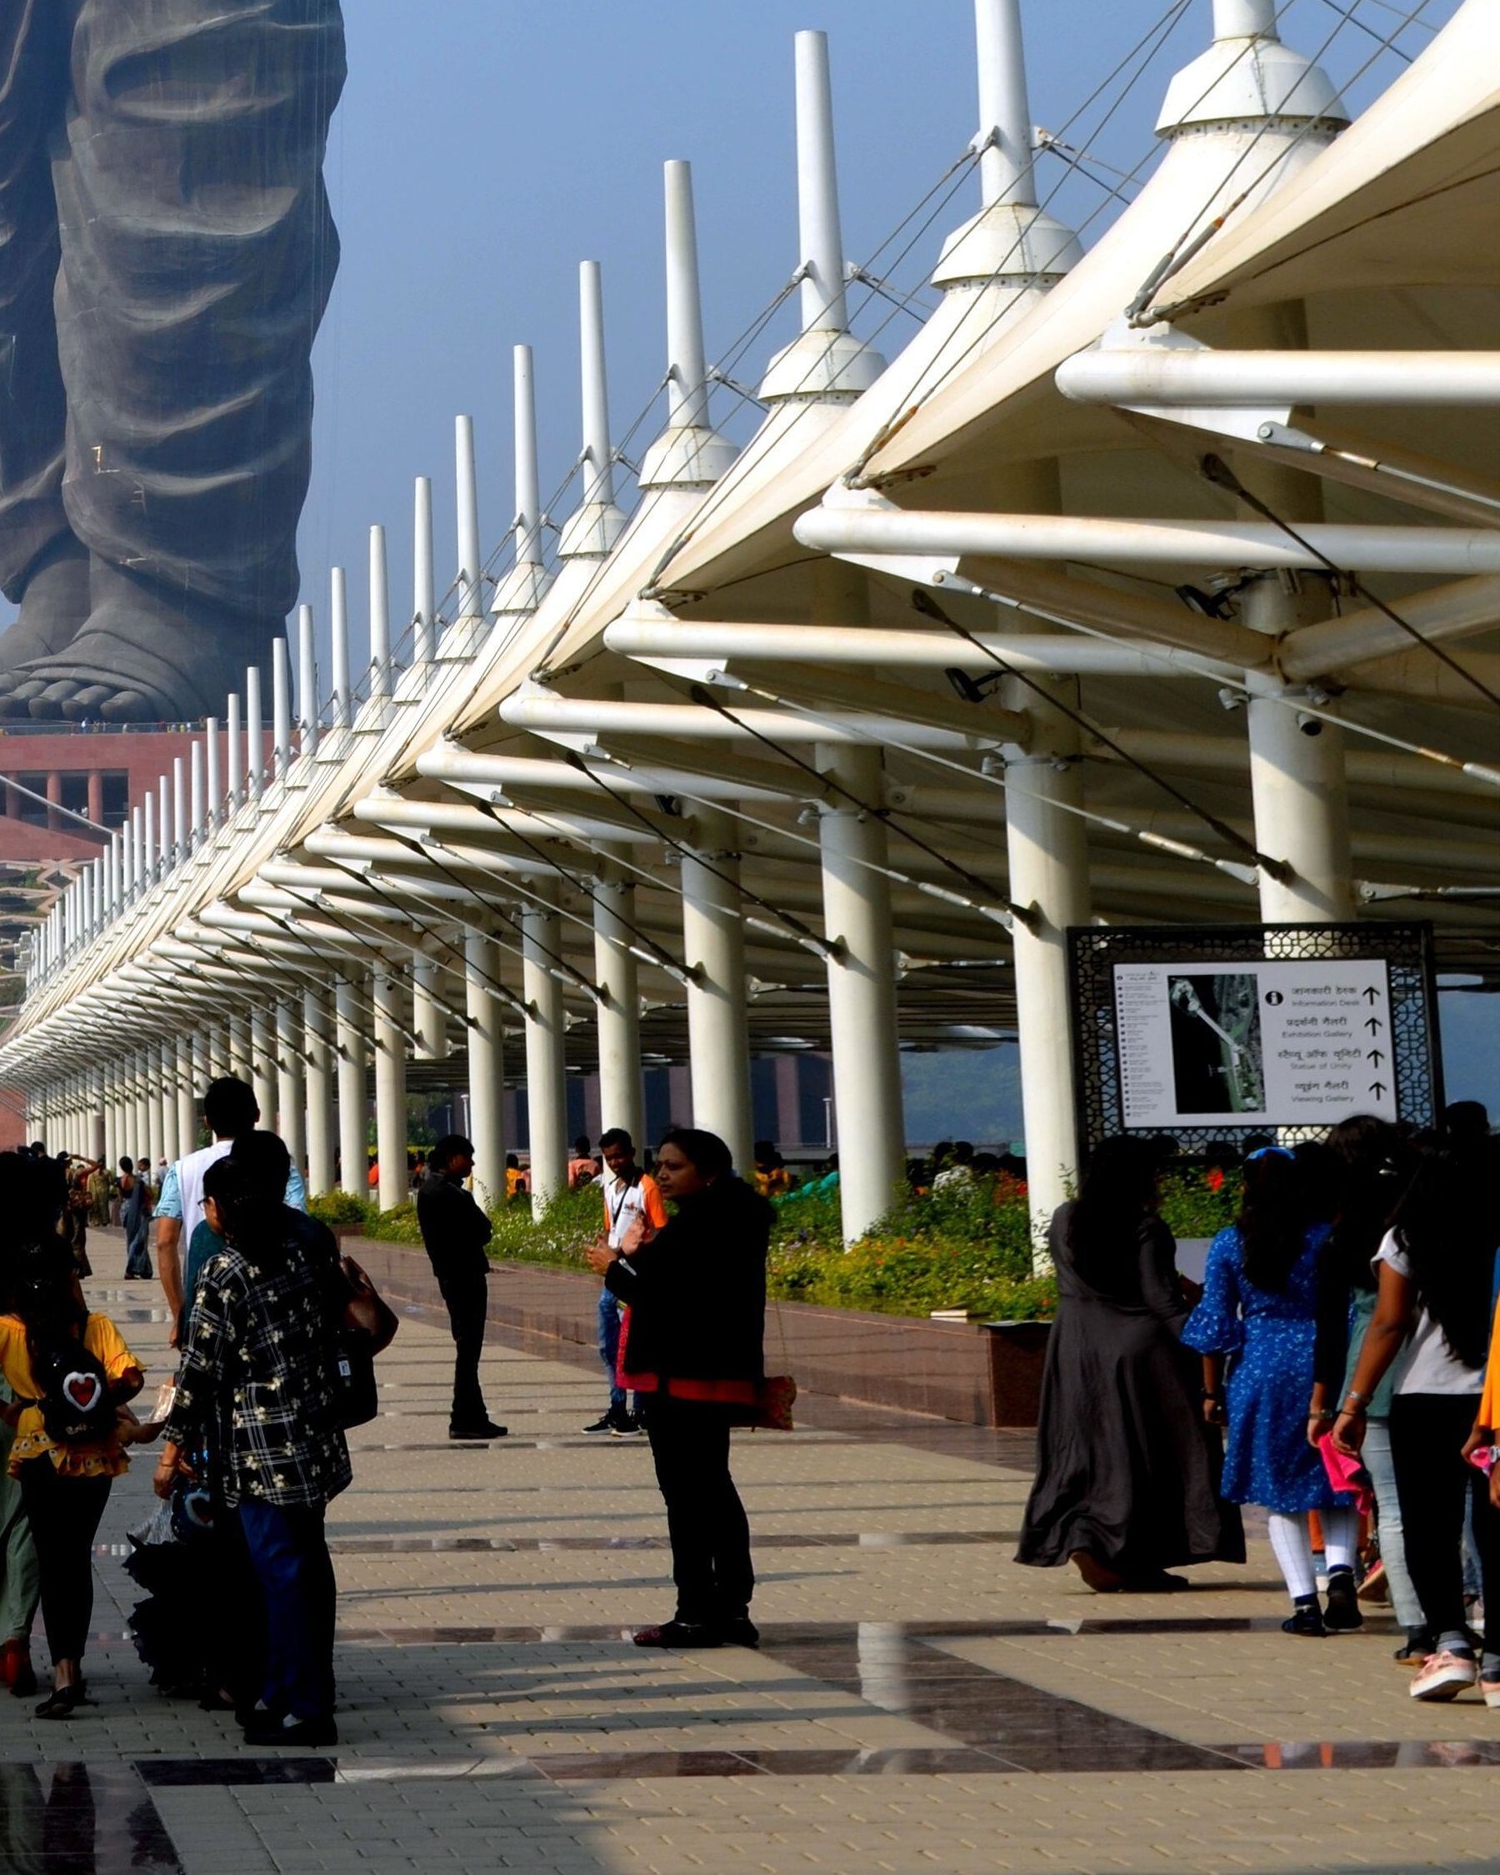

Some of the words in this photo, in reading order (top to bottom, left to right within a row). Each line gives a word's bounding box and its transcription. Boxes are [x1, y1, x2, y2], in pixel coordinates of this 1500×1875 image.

[1323, 1031, 1353, 1039] Gallery
[1330, 1062, 1353, 1070] Unity
[1290, 1095, 1323, 1103] Viewing
[1325, 1095, 1354, 1103] Gallery
